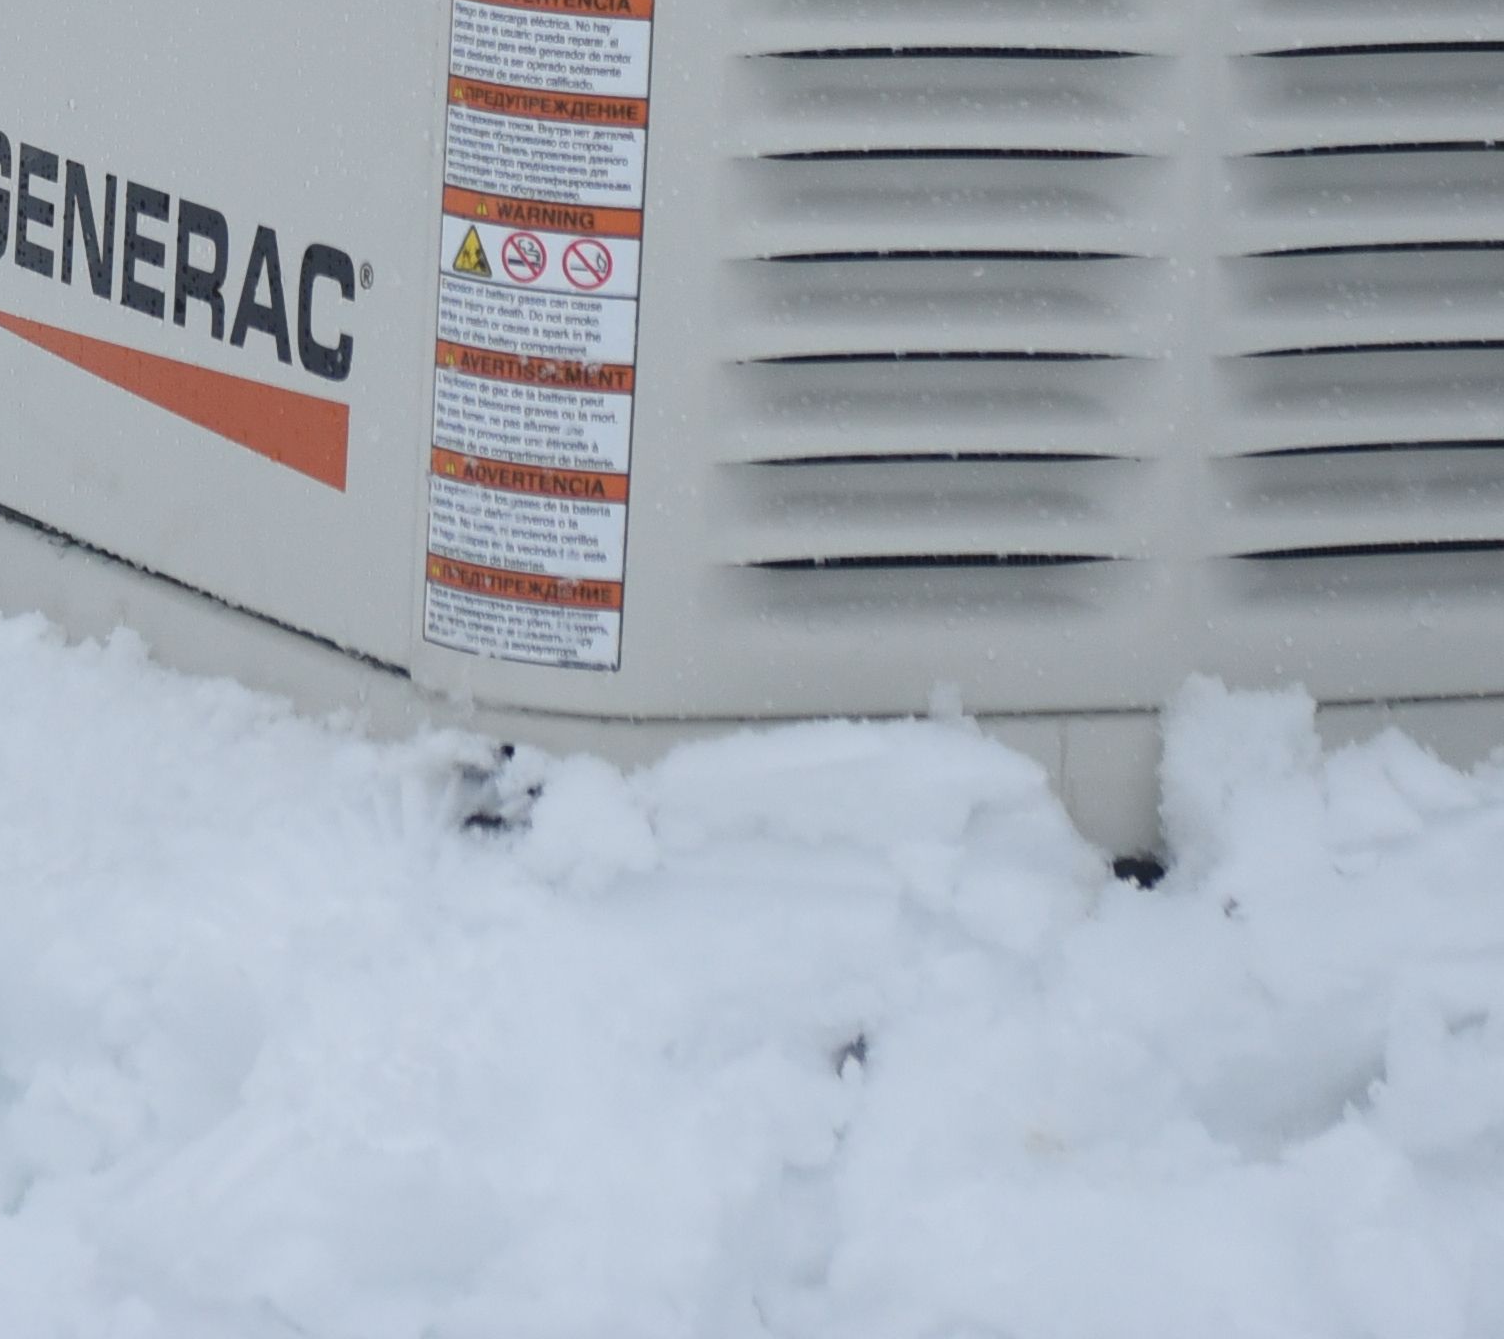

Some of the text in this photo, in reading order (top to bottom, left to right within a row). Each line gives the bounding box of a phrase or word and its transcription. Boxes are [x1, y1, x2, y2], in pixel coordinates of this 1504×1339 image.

[576, 21, 590, 32] No
[593, 22, 611, 36] hay
[535, 31, 566, 47] pueda
[610, 38, 618, 49] el
[539, 45, 586, 63] generador
[589, 51, 601, 62] de
[604, 52, 631, 64] motor
[527, 58, 566, 76] operado
[569, 63, 622, 78] solamente
[498, 203, 595, 230] WARNING
[549, 299, 568, 308] can
[571, 301, 602, 311] cause
[529, 309, 543, 321] Do
[546, 311, 562, 323] not
[543, 325, 570, 341] spark
[573, 329, 582, 340] in
[585, 330, 601, 341] the
[512, 386, 523, 398] de
[538, 390, 577, 404] batterie
[580, 395, 604, 409] peut
[524, 406, 559, 421] graves
[562, 411, 575, 420] ou
[578, 410, 587, 421] la
[559, 455, 570, 466] de
[543, 500, 556, 512] de
[559, 502, 569, 513] la
